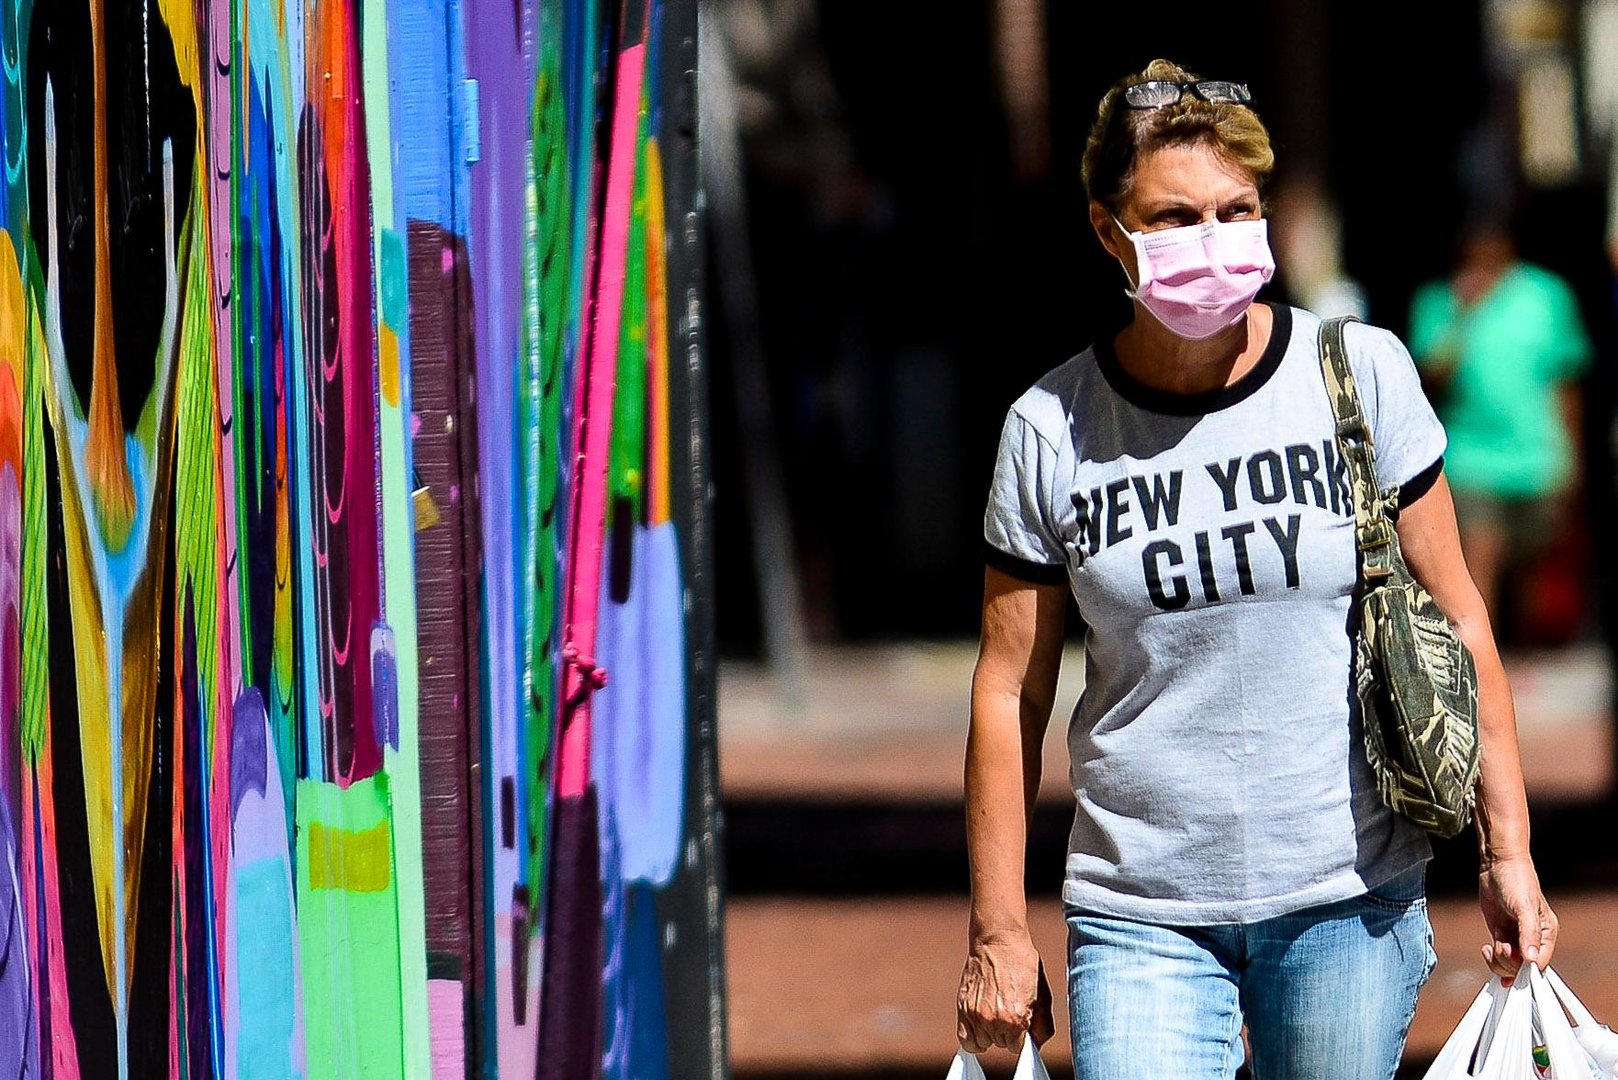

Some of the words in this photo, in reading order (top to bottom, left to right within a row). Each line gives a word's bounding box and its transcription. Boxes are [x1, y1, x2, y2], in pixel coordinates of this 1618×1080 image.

[1070, 469, 1183, 558] NEW
[1204, 438, 1354, 518] YORK
[1141, 512, 1301, 611] CITY
